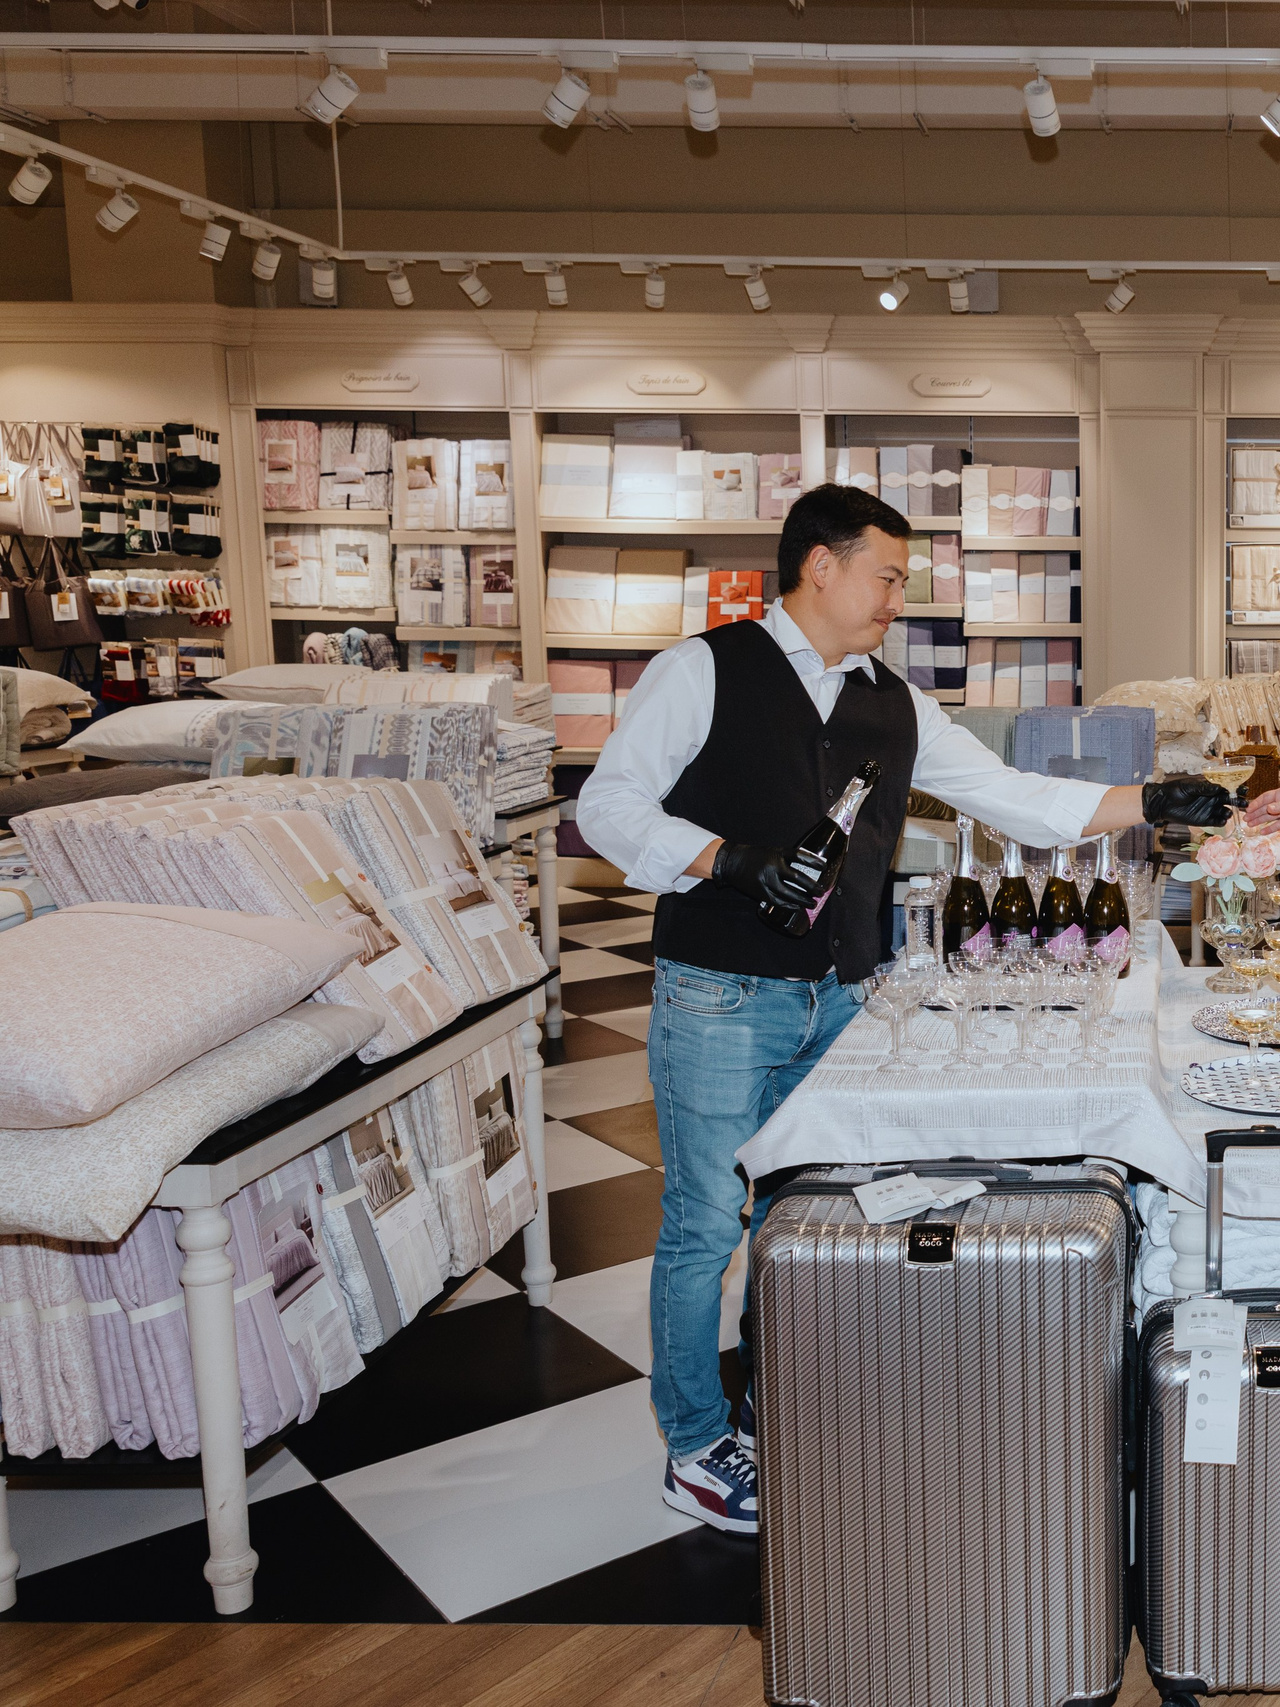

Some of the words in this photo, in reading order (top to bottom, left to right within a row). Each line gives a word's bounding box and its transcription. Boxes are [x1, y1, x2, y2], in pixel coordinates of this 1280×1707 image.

[638, 374, 661, 387] Tapis
[662, 375, 671, 384] de
[672, 375, 690, 384] bain
